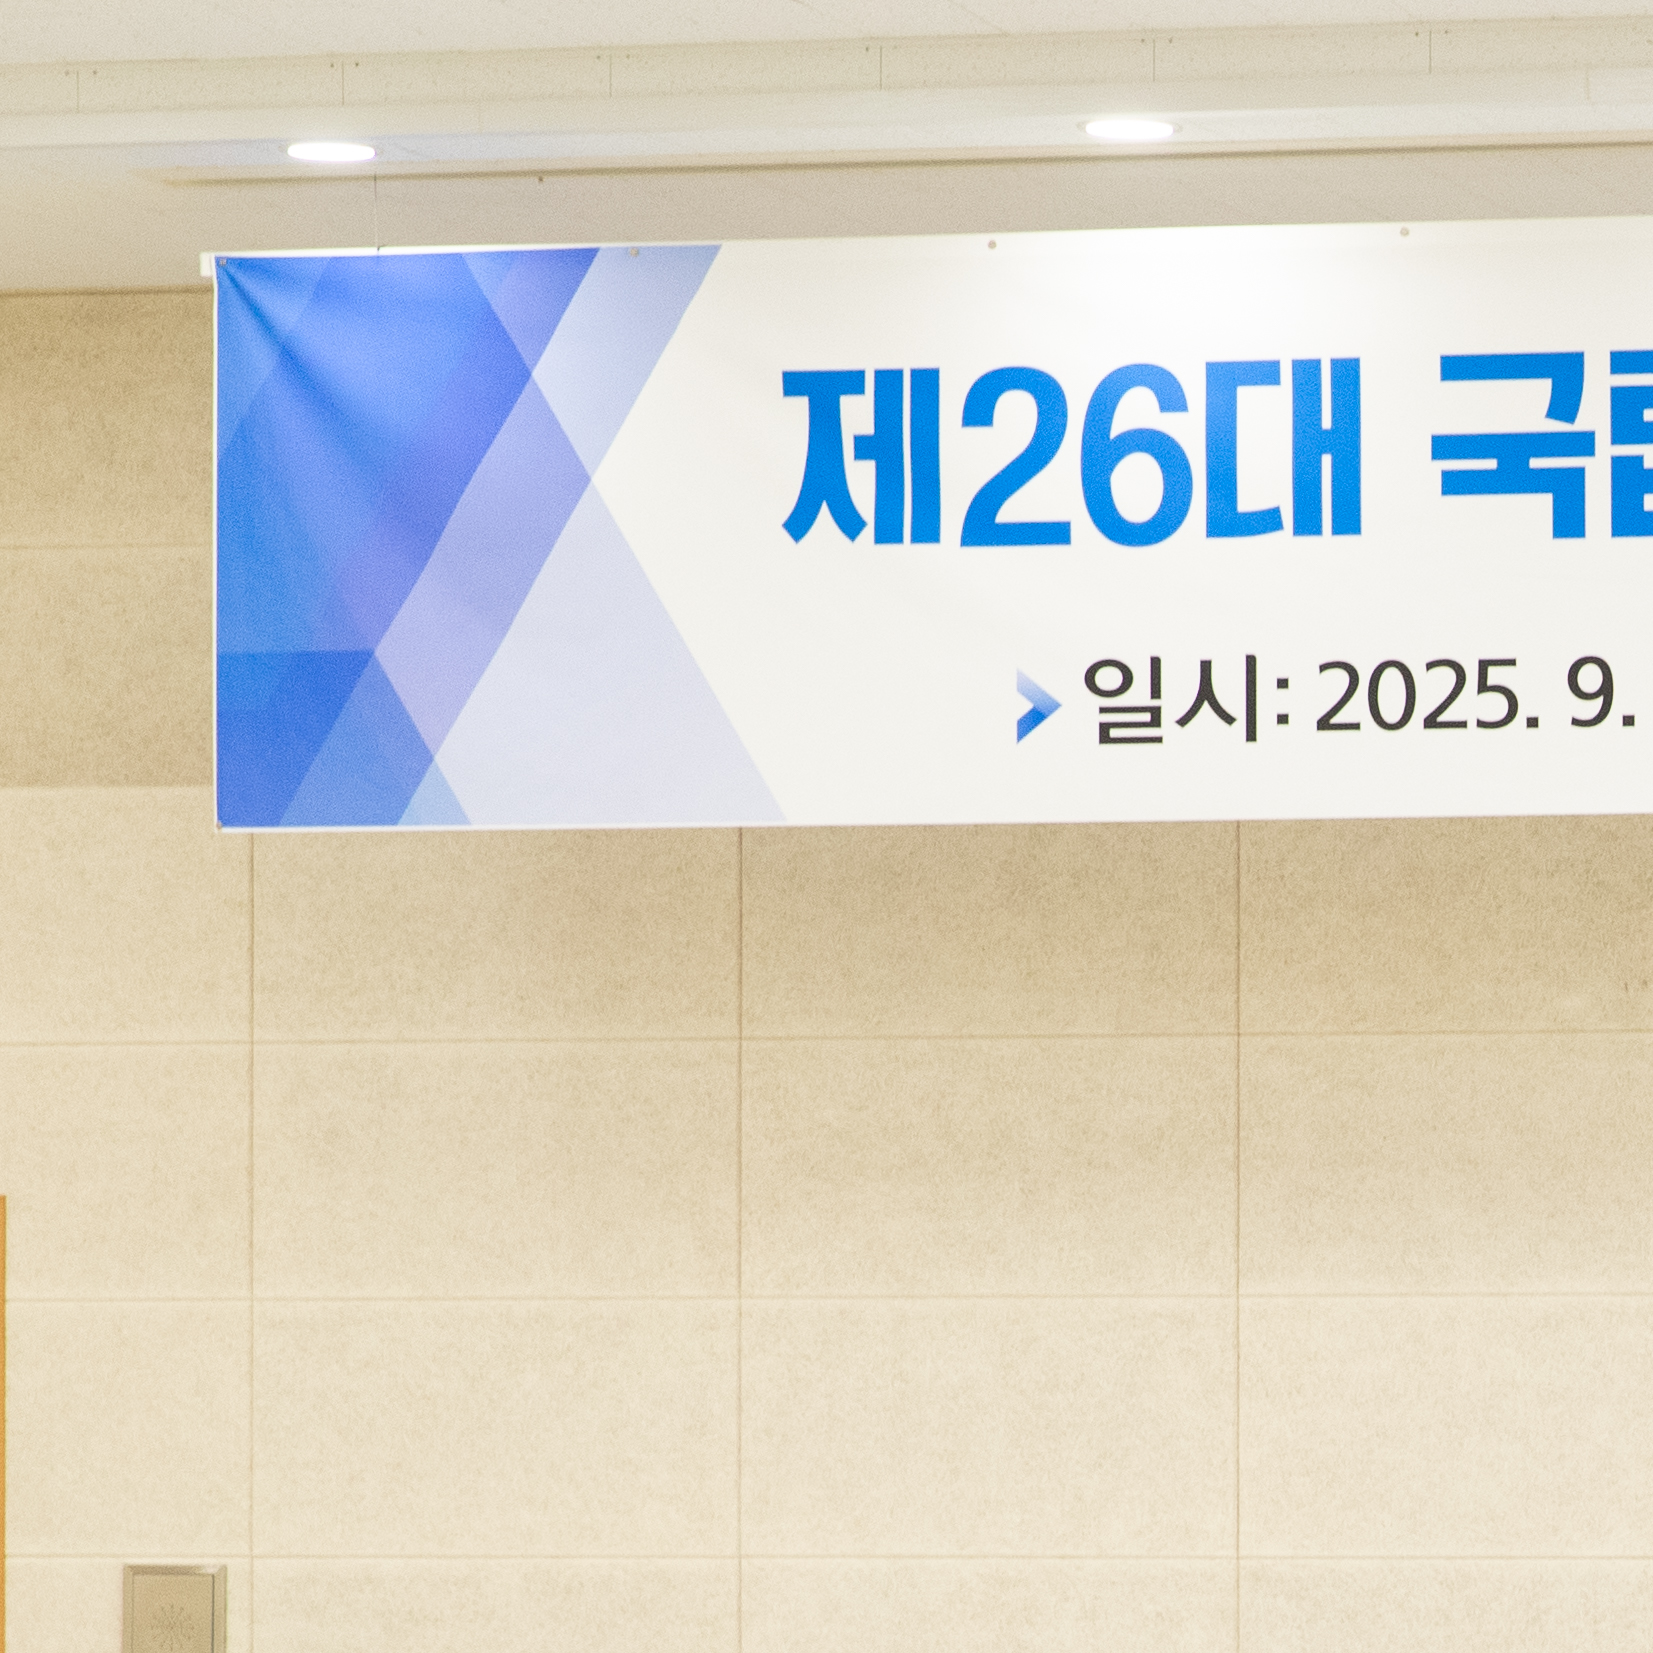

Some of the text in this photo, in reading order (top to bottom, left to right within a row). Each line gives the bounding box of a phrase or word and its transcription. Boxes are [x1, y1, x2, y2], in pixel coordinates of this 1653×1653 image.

[782, 358, 1361, 547] 제26대
[1084, 655, 1289, 744] 일시:
[1317, 659, 1539, 731] 2025.
[1568, 656, 1635, 727] 9.
